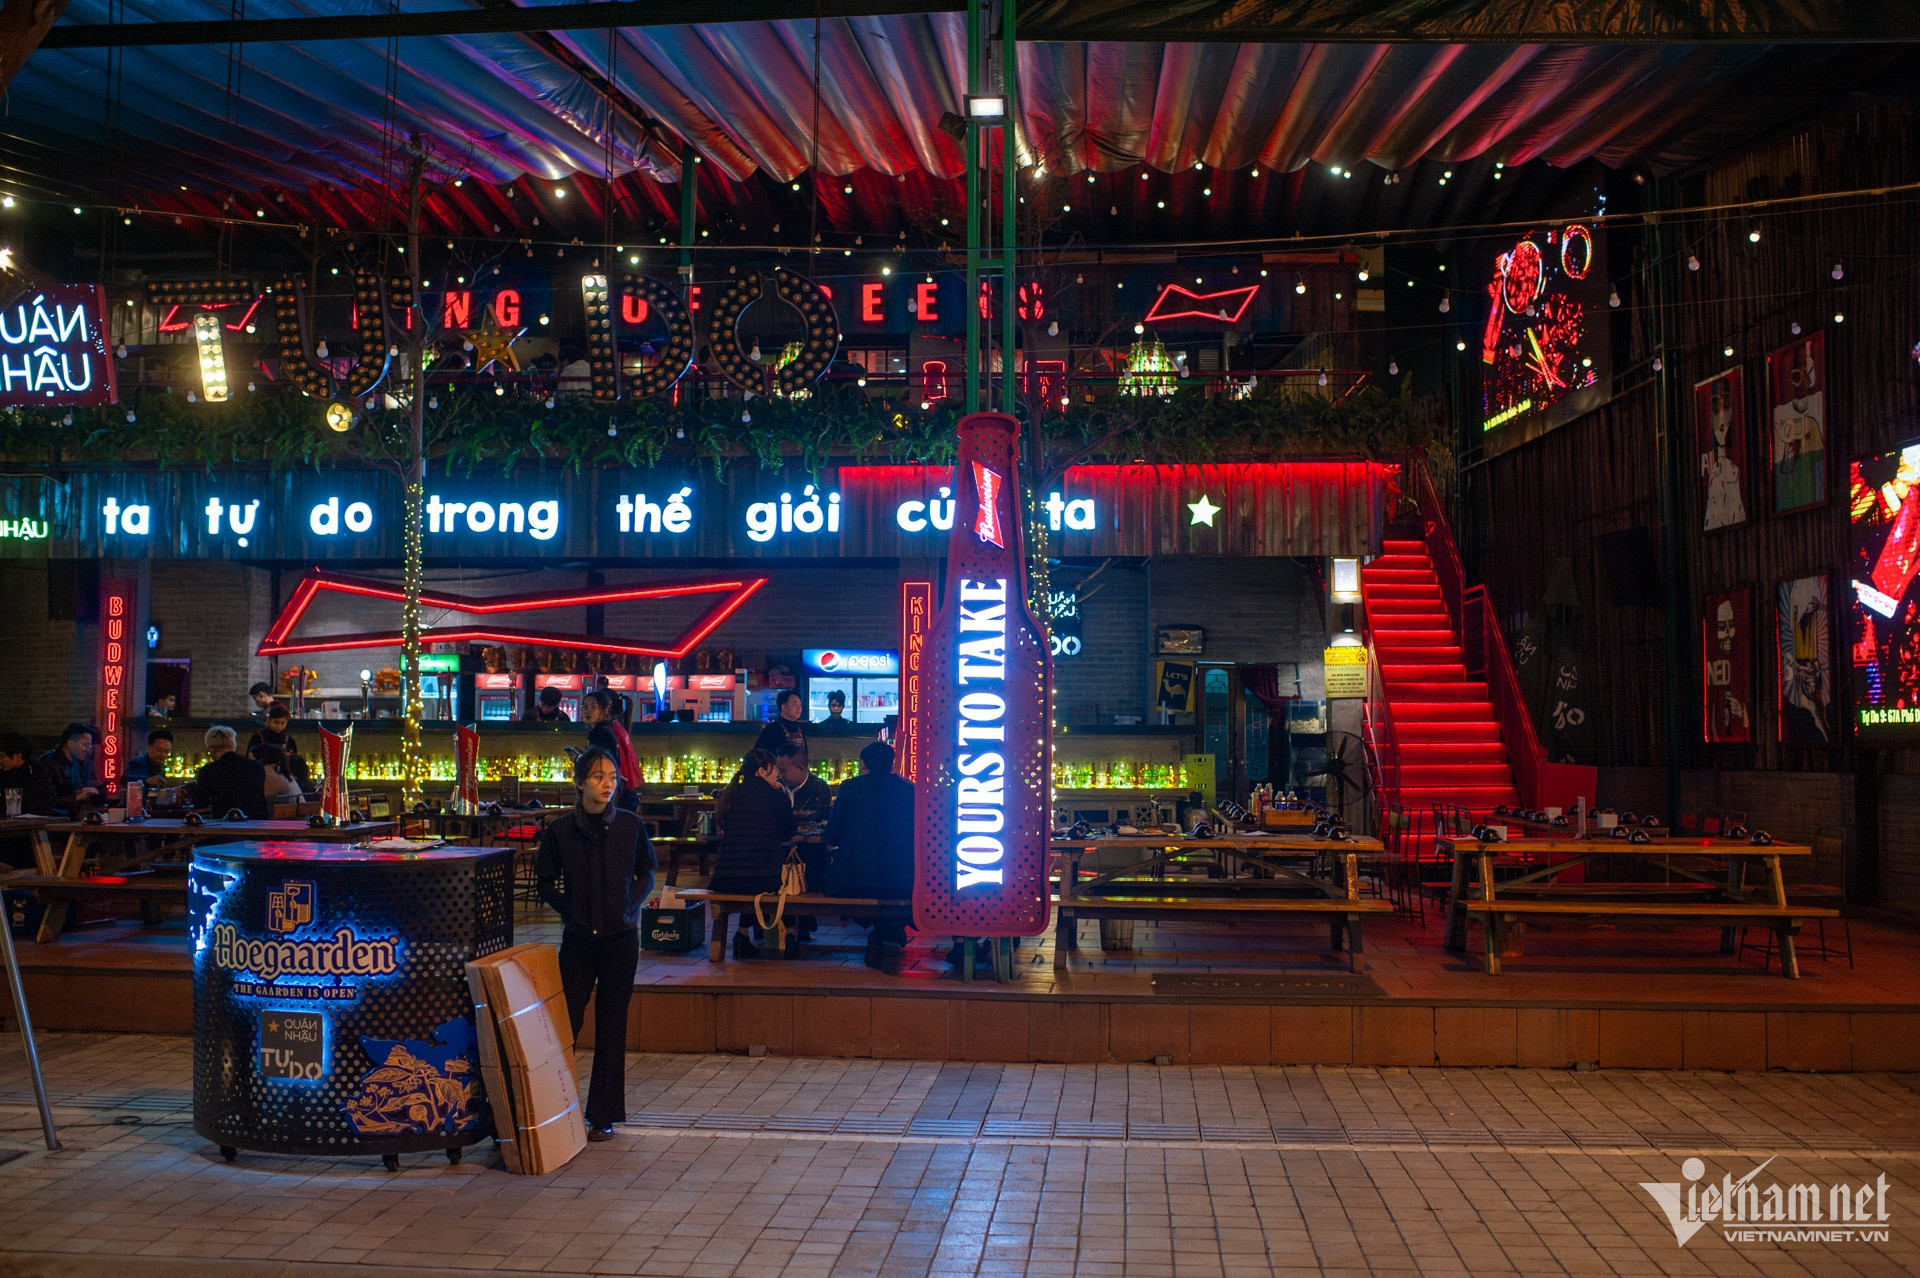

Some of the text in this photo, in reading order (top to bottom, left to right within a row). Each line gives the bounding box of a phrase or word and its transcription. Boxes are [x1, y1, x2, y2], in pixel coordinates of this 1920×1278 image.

[0, 293, 88, 345] UÁN
[0, 345, 91, 397] HẬU
[103, 497, 150, 535] ta
[205, 497, 260, 548] tự
[310, 496, 372, 536] do
[426, 495, 560, 542] trong
[616, 486, 693, 534] thế
[896, 485, 956, 533] củ
[1044, 492, 1096, 533] ta
[979, 467, 995, 542] Budweiser
[846, 653, 890, 670] pepsi
[1165, 670, 1189, 681] LET'S
[956, 578, 1007, 891] YOURS TO TAKE
[214, 924, 397, 981] Hoegaarden
[651, 929, 680, 942] Carlsberg
[234, 983, 354, 999] THE GAARDEN IS OPEN
[284, 1030, 318, 1043] NHẬU
[260, 1047, 322, 1080] TỰ DO
